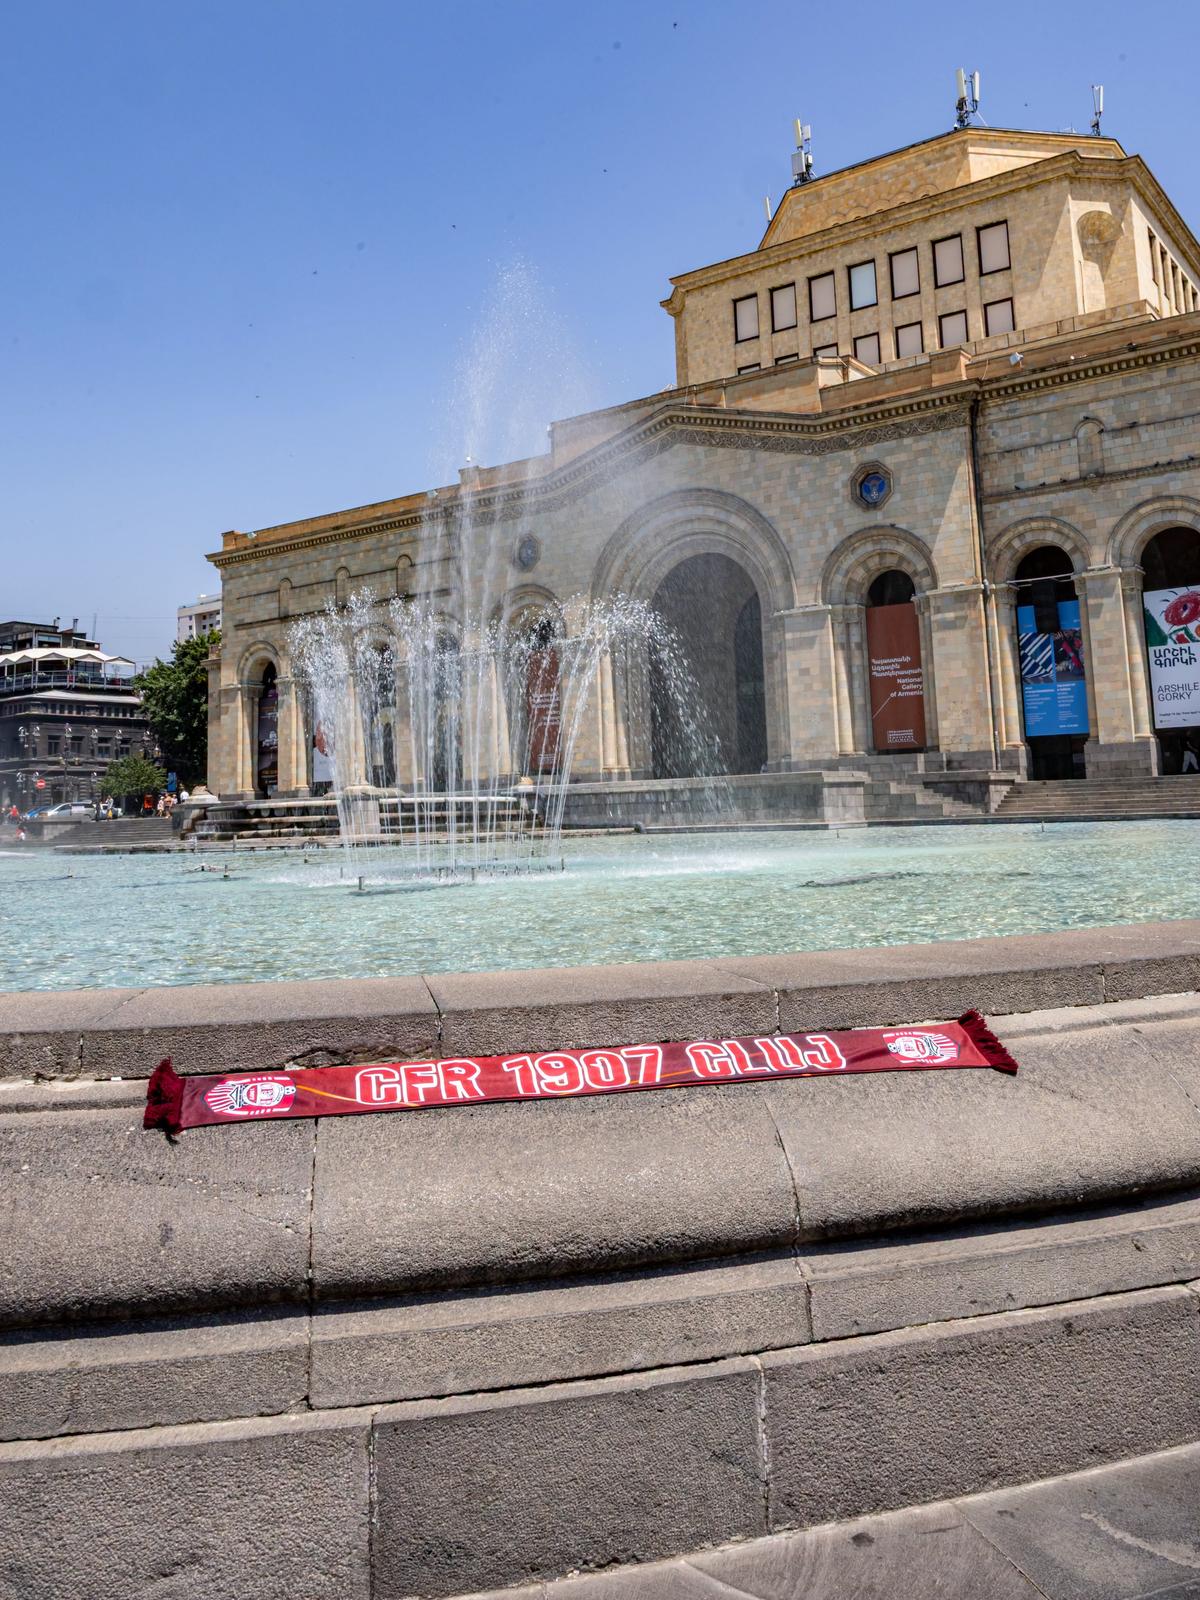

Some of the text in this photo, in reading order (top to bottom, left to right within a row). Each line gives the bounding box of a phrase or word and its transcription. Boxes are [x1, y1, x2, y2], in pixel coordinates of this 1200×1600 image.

[1154, 656, 1197, 668] ԳՈՐԿԻ
[1157, 682, 1199, 693] ARSHILE
[1158, 692, 1192, 702] GORKY
[355, 1035, 847, 1105] CFR 1907 CLUJ
